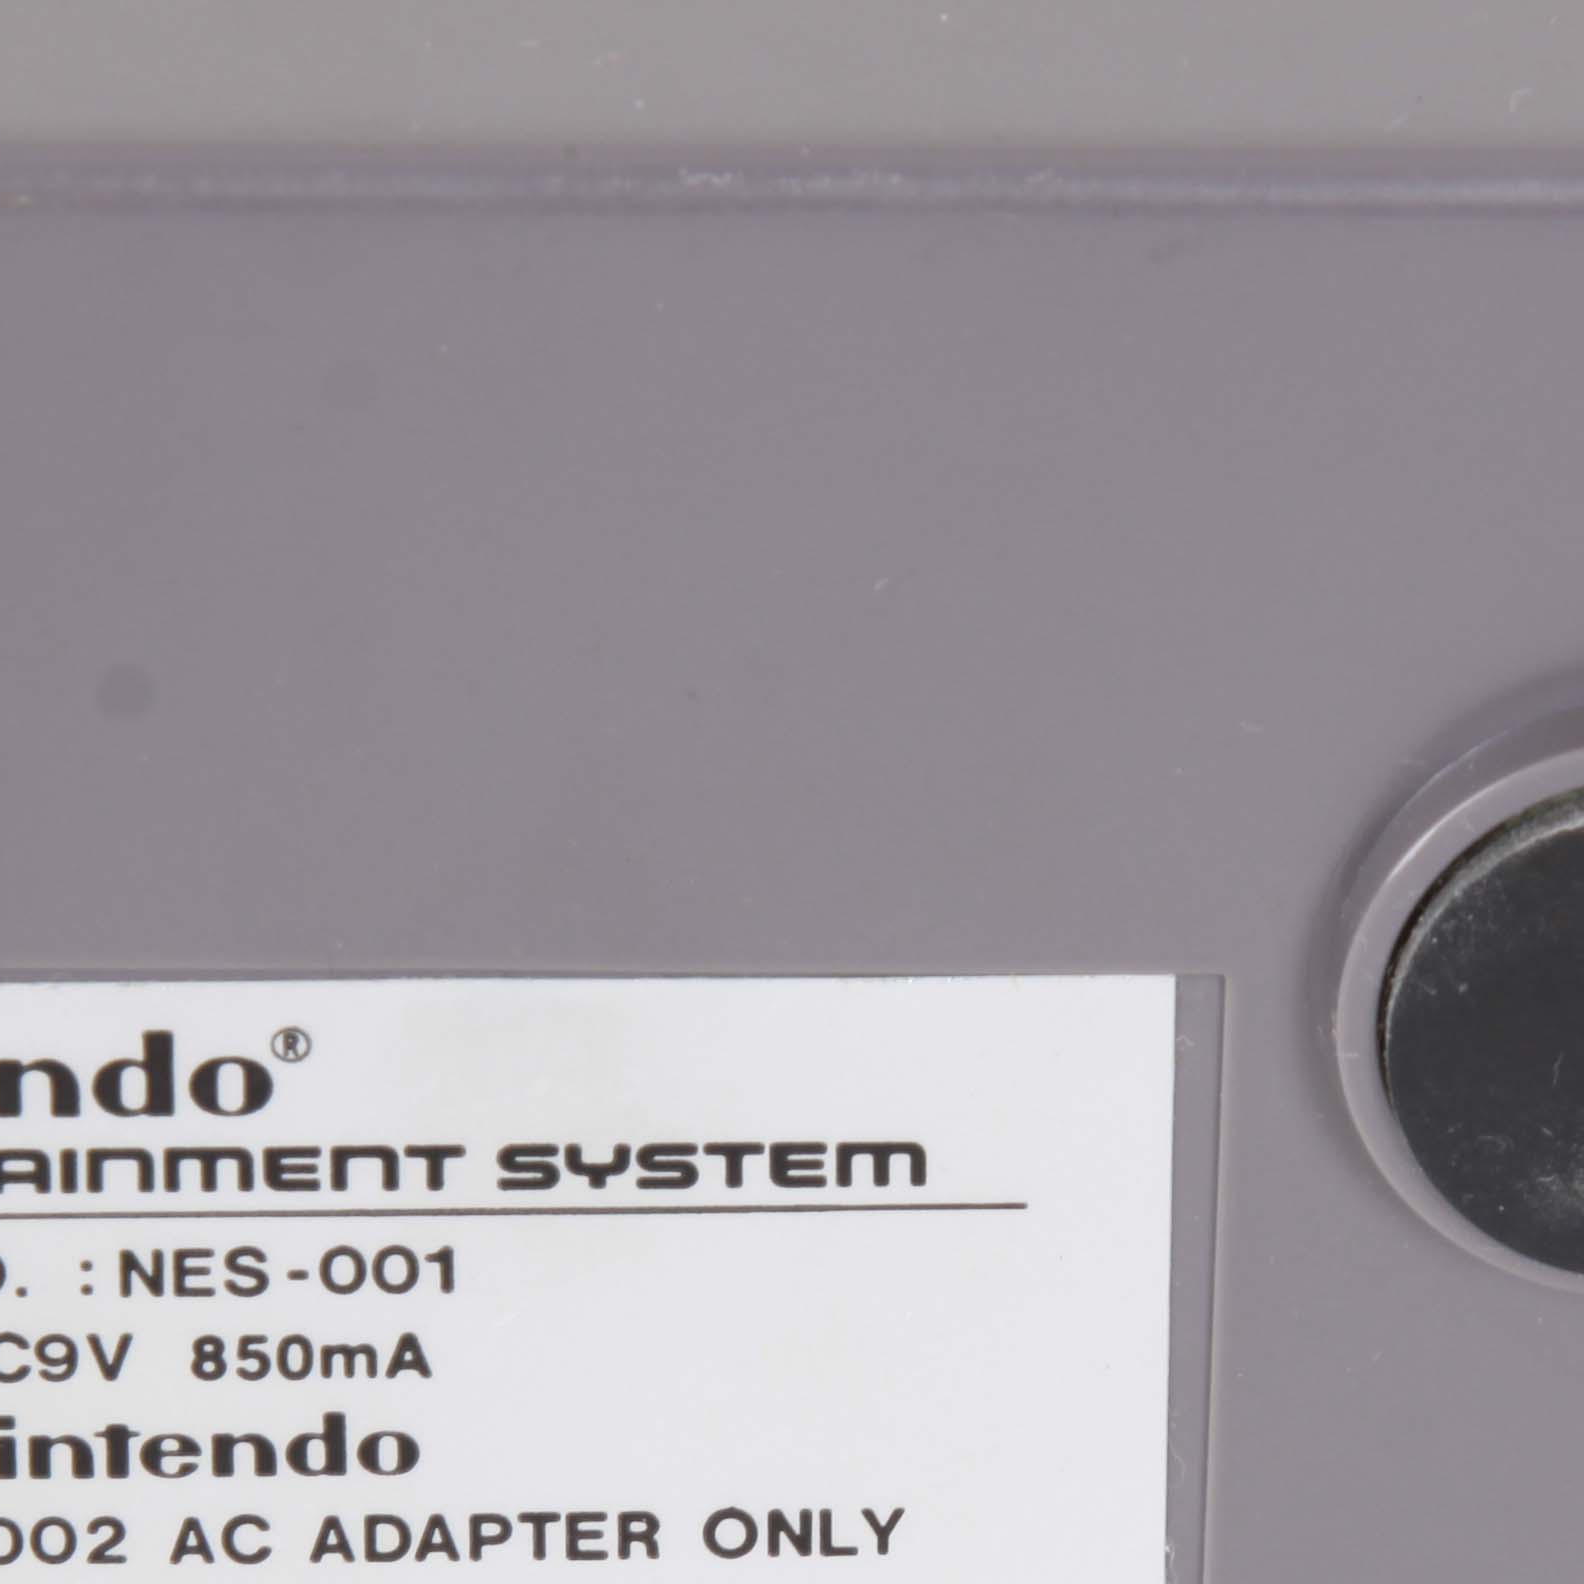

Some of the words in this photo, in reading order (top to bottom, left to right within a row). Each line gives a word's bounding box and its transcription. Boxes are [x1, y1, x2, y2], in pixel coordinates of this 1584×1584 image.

[497, 1142, 927, 1191] SYSTEM
[191, 1333, 431, 1381] 850mA
[170, 1514, 271, 1565] AC
[310, 1511, 660, 1563] ADAPTER
[703, 1507, 905, 1559] ONLY
